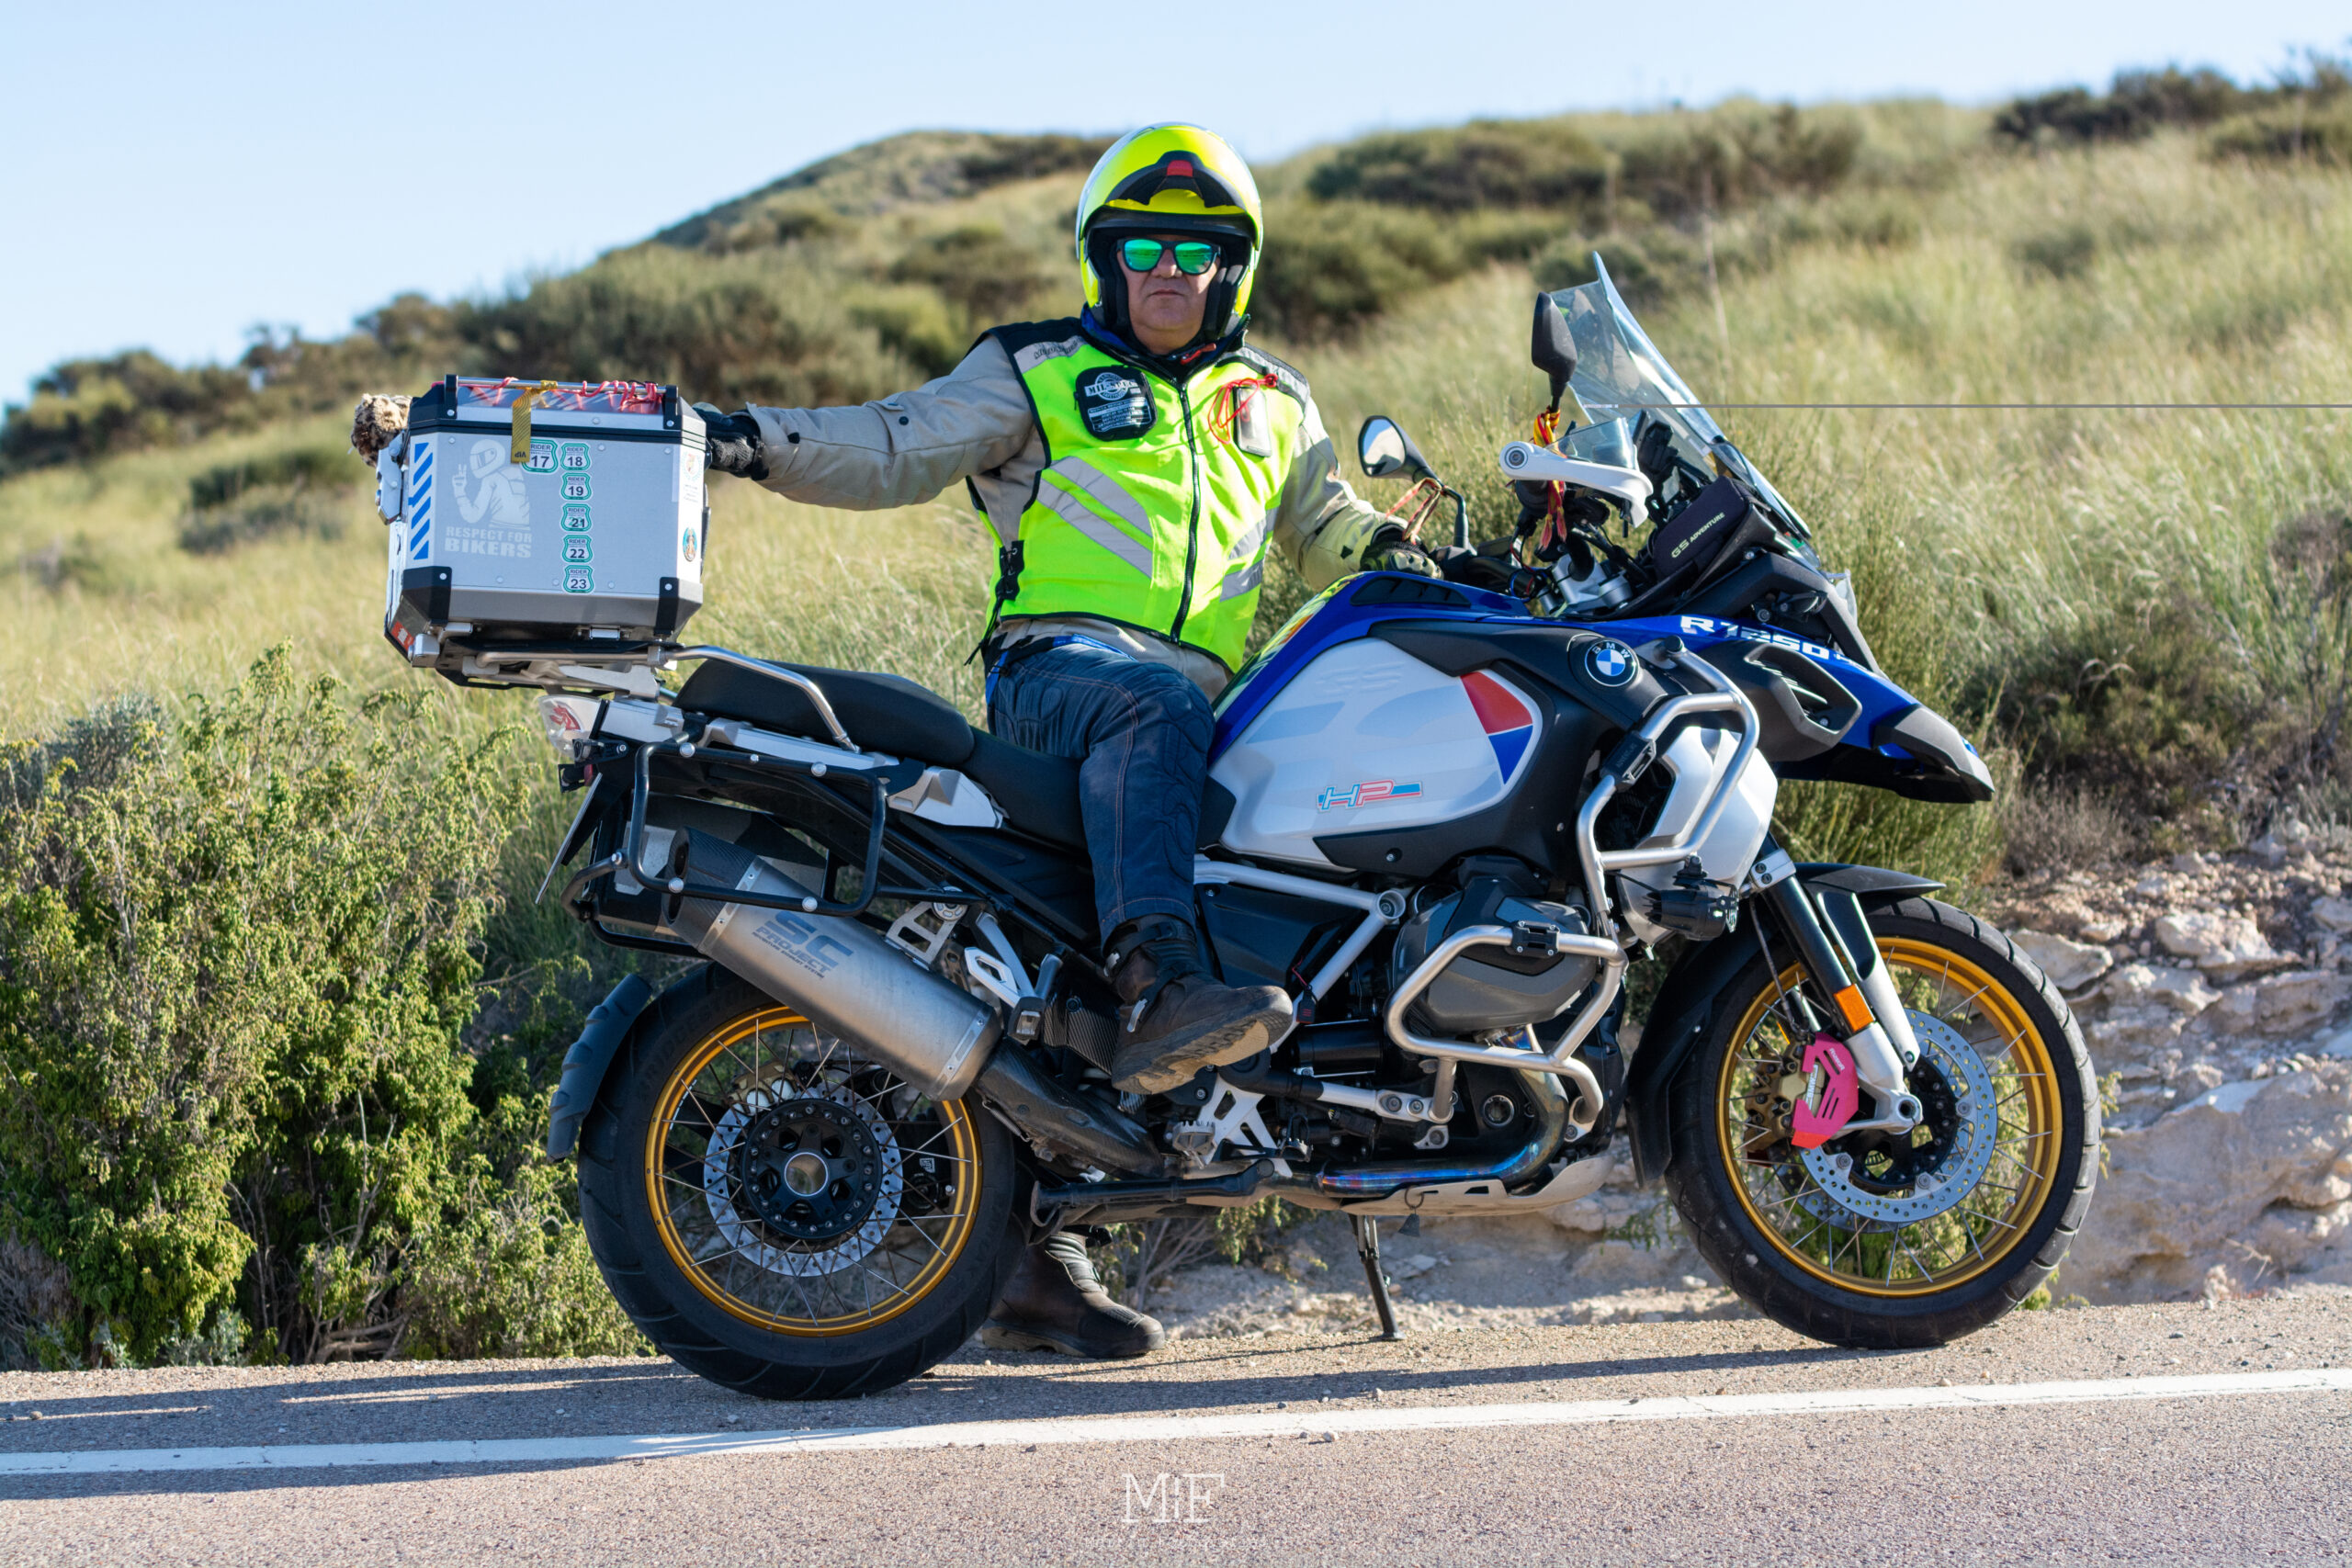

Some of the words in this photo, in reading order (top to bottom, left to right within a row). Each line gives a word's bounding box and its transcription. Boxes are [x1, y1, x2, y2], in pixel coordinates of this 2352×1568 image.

[531, 455, 550, 468] 17
[567, 456, 582, 467] 18
[568, 485, 584, 497] 19
[571, 517, 585, 528] 21
[446, 525, 504, 542] RESPECT
[507, 531, 533, 544] FOR
[1671, 538, 1690, 558] GS
[1690, 512, 1725, 543] ADVENTURE
[445, 536, 532, 558] BIKERS
[570, 548, 585, 559] 22
[571, 579, 587, 590] 23
[1592, 642, 1630, 659] BMW
[1321, 780, 1395, 811] HP
[764, 910, 854, 968] SC
[755, 926, 832, 974] PROJECT
